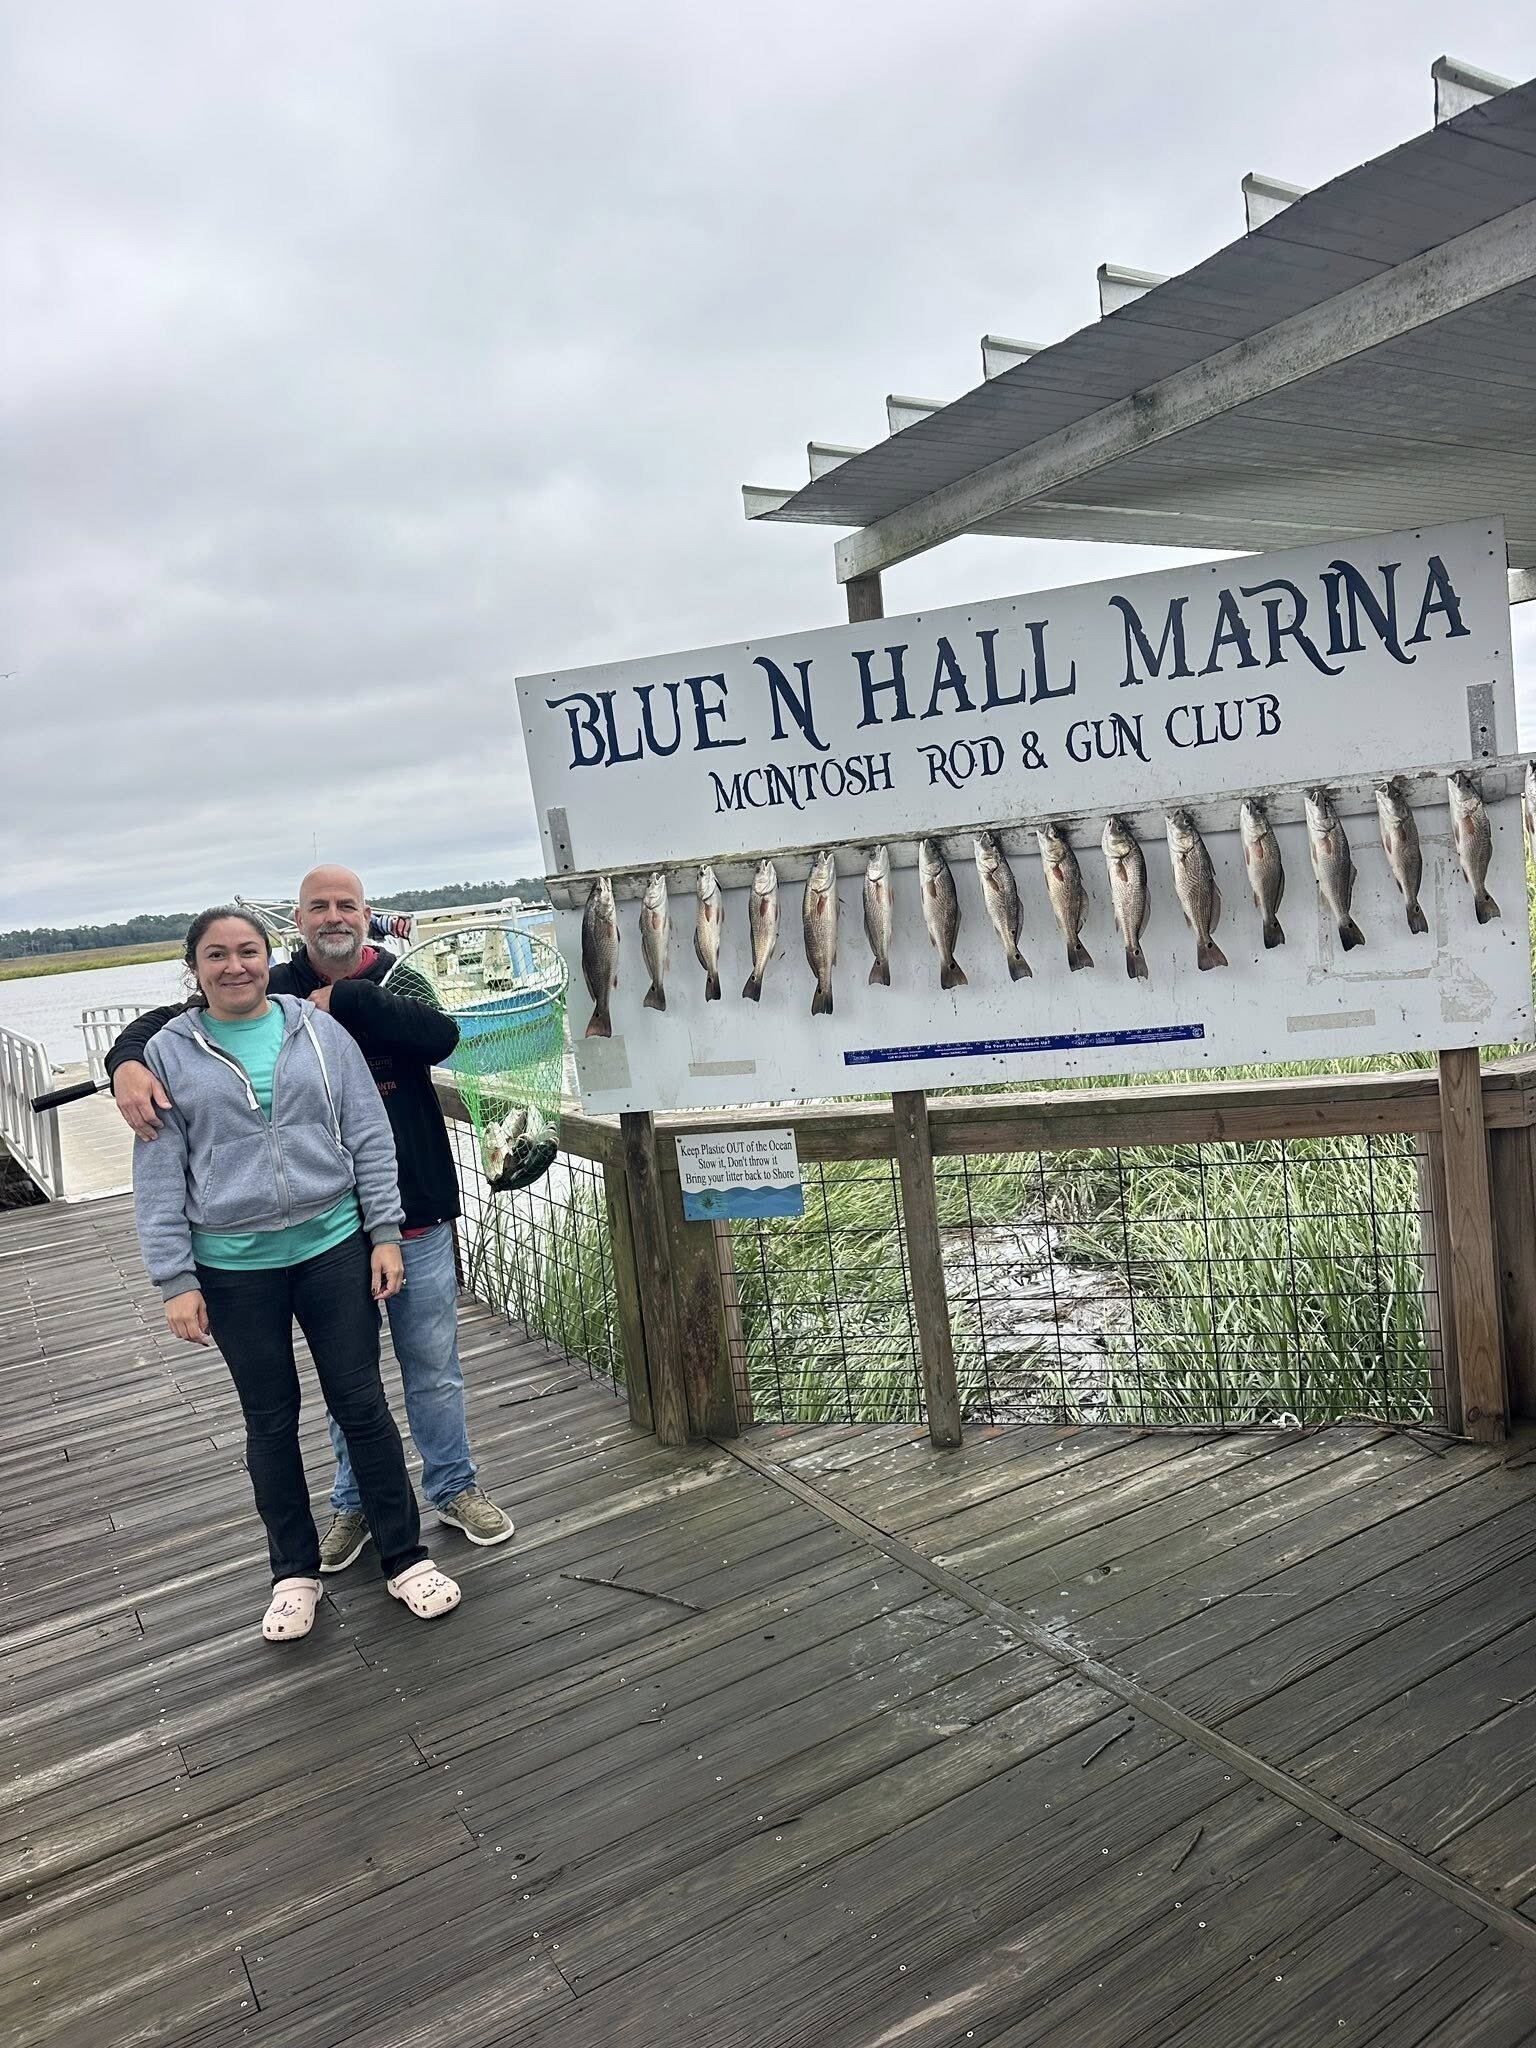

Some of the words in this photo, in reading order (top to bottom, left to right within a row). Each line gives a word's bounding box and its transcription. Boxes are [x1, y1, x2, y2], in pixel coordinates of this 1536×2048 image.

[545, 673, 746, 770] BLUE
[753, 656, 830, 751] N
[851, 620, 1076, 729] HALL
[1108, 555, 1471, 687] MARINA
[708, 752, 895, 813] MCINTOSH
[917, 736, 1004, 789] ROD
[1022, 731, 1048, 770] &
[1066, 712, 1151, 763] GUN
[1164, 694, 1281, 749] CLUB
[681, 1145, 700, 1158] Keep
[701, 1143, 725, 1155] Plastic
[726, 1141, 745, 1154] OUT
[746, 1141, 755, 1152] of
[755, 1141, 767, 1152] the
[768, 1140, 792, 1151] Ocean
[698, 1158, 716, 1170] Stow
[718, 1157, 726, 1169] it,
[728, 1156, 748, 1168] Don't
[749, 1155, 770, 1167] throw
[772, 1155, 778, 1165] it
[685, 1172, 707, 1186] Bring
[707, 1173, 724, 1185] your
[725, 1170, 743, 1182] litter
[744, 1169, 761, 1181] back
[763, 1170, 772, 1180] to
[772, 1168, 794, 1180] Shore
